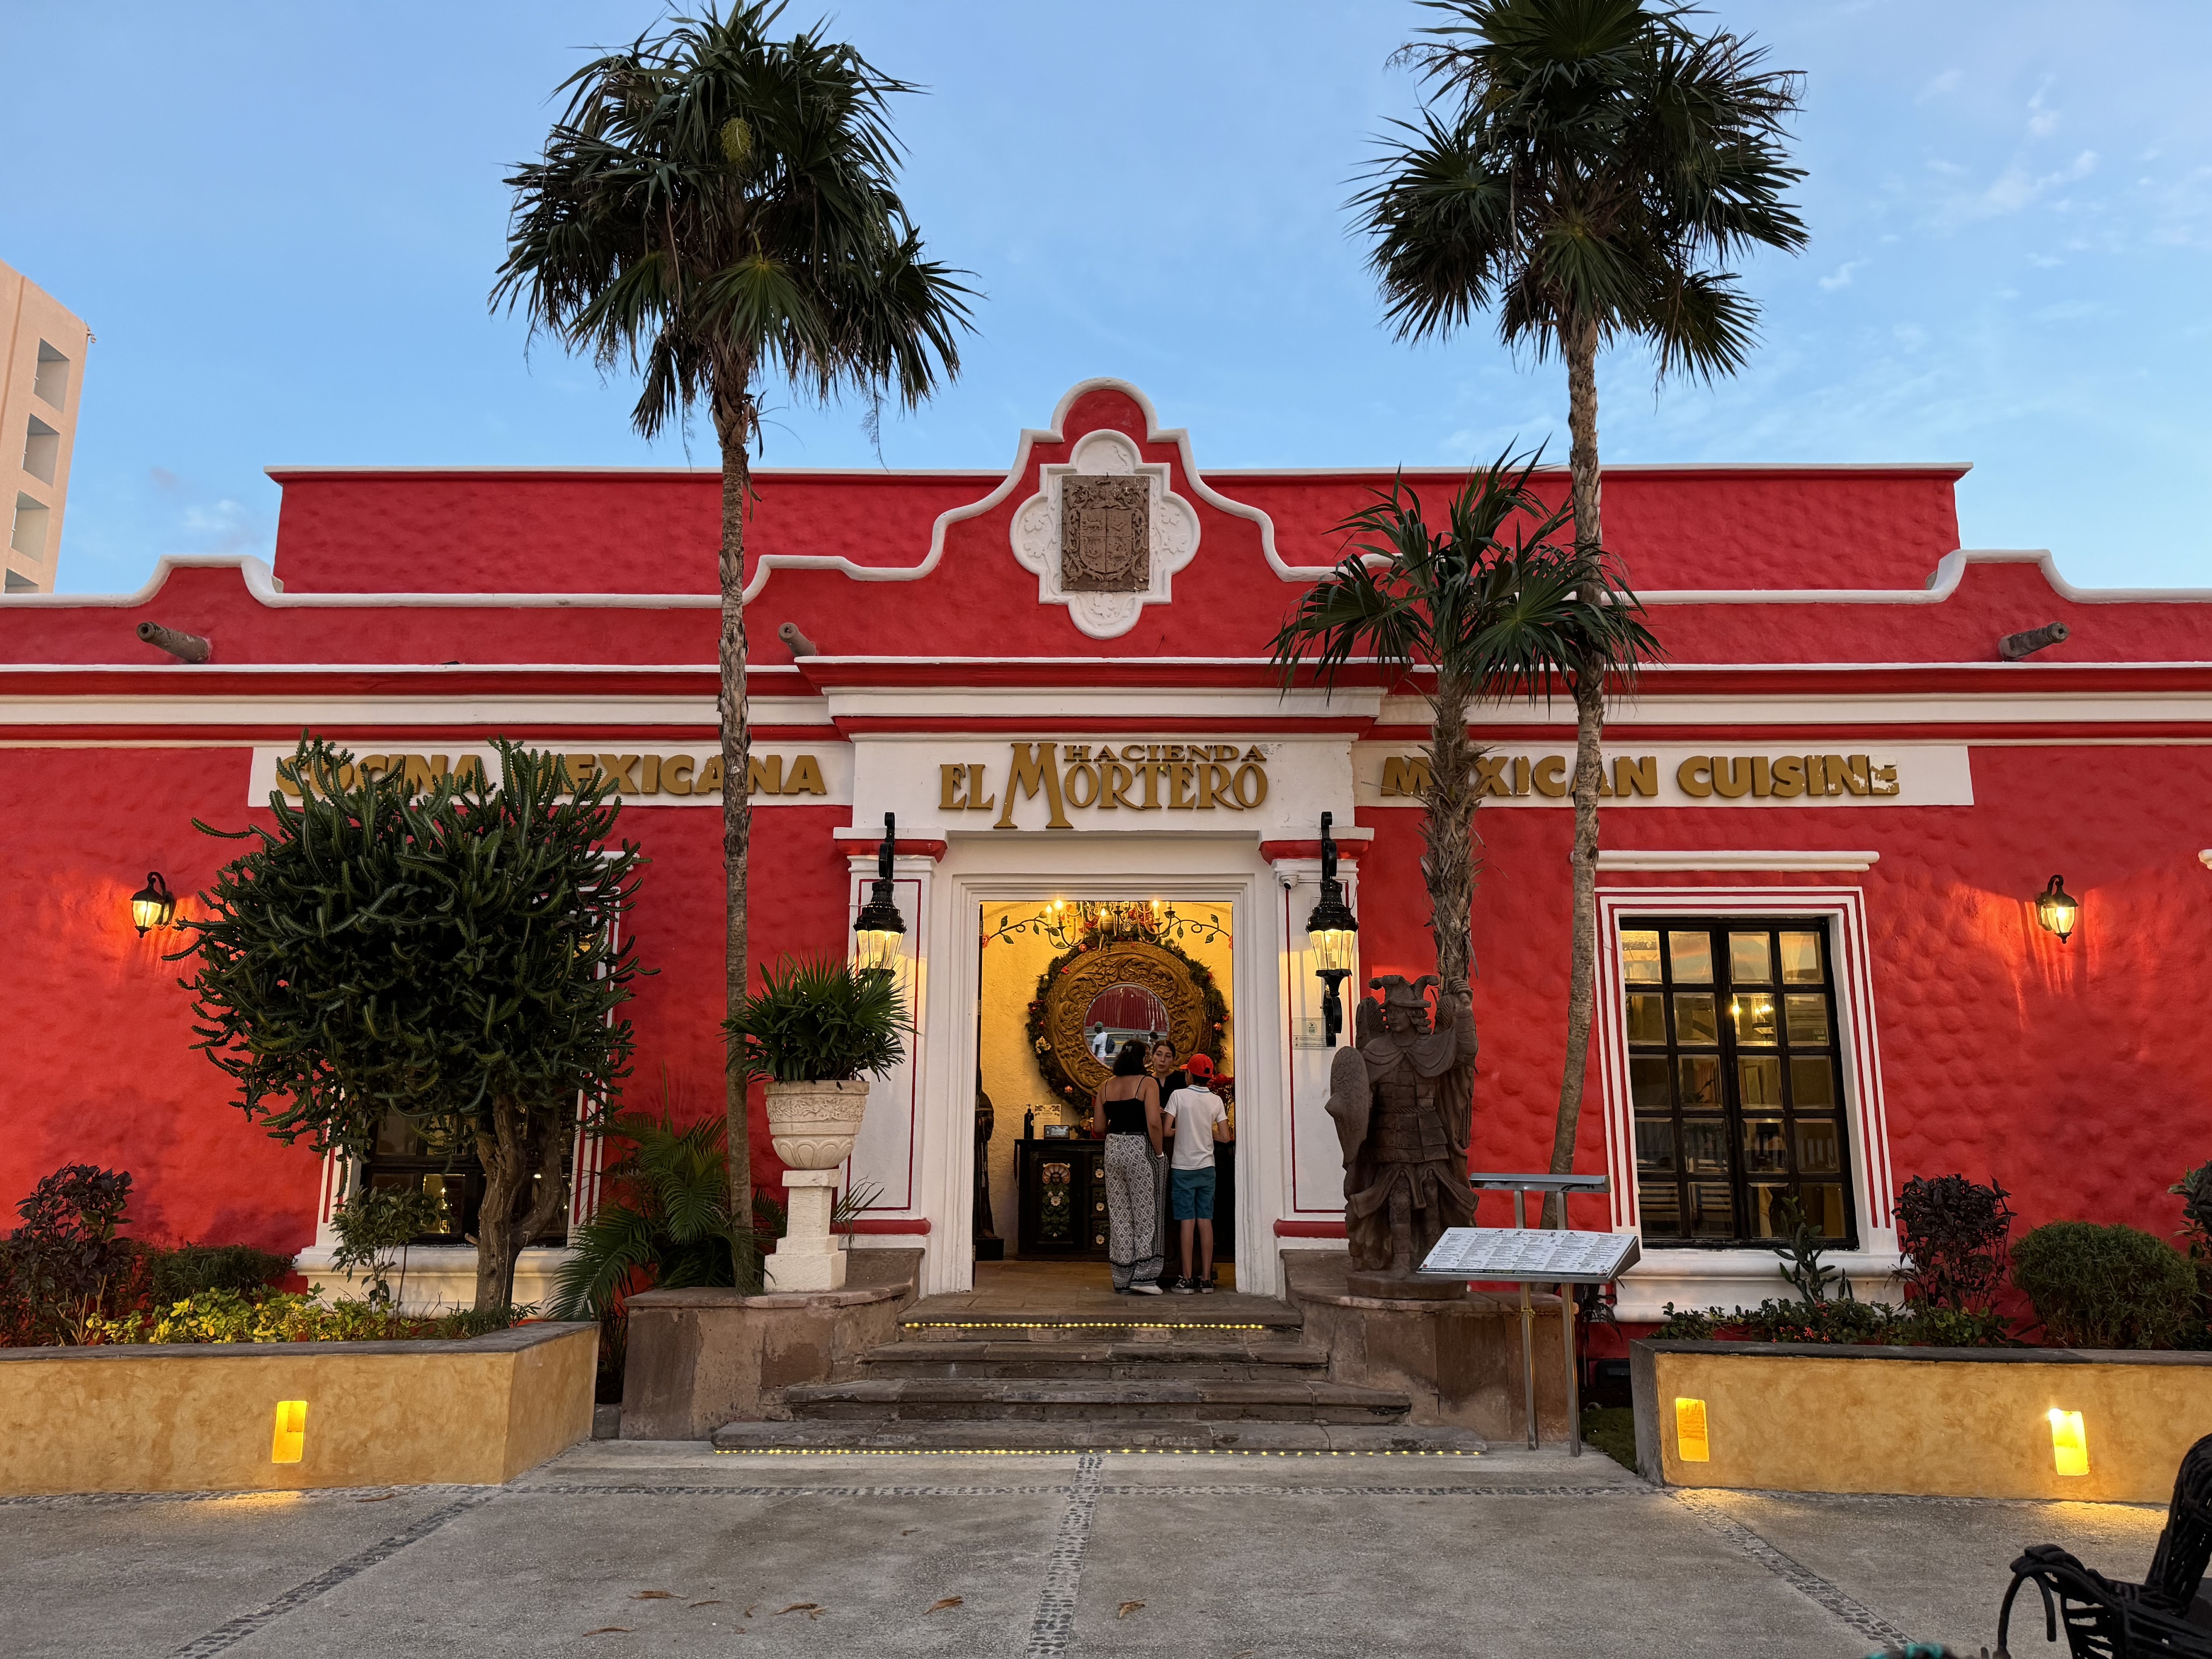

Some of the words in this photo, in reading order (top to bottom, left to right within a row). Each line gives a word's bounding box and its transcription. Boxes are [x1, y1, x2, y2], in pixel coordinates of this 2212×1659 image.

[1064, 745, 1267, 762] HACIENDA
[506, 754, 827, 795] EXICANA
[938, 763, 994, 810] EL
[993, 742, 1268, 829] MORTERO
[1380, 755, 1658, 797] MXICN
[1677, 755, 1900, 797] CUISINE
